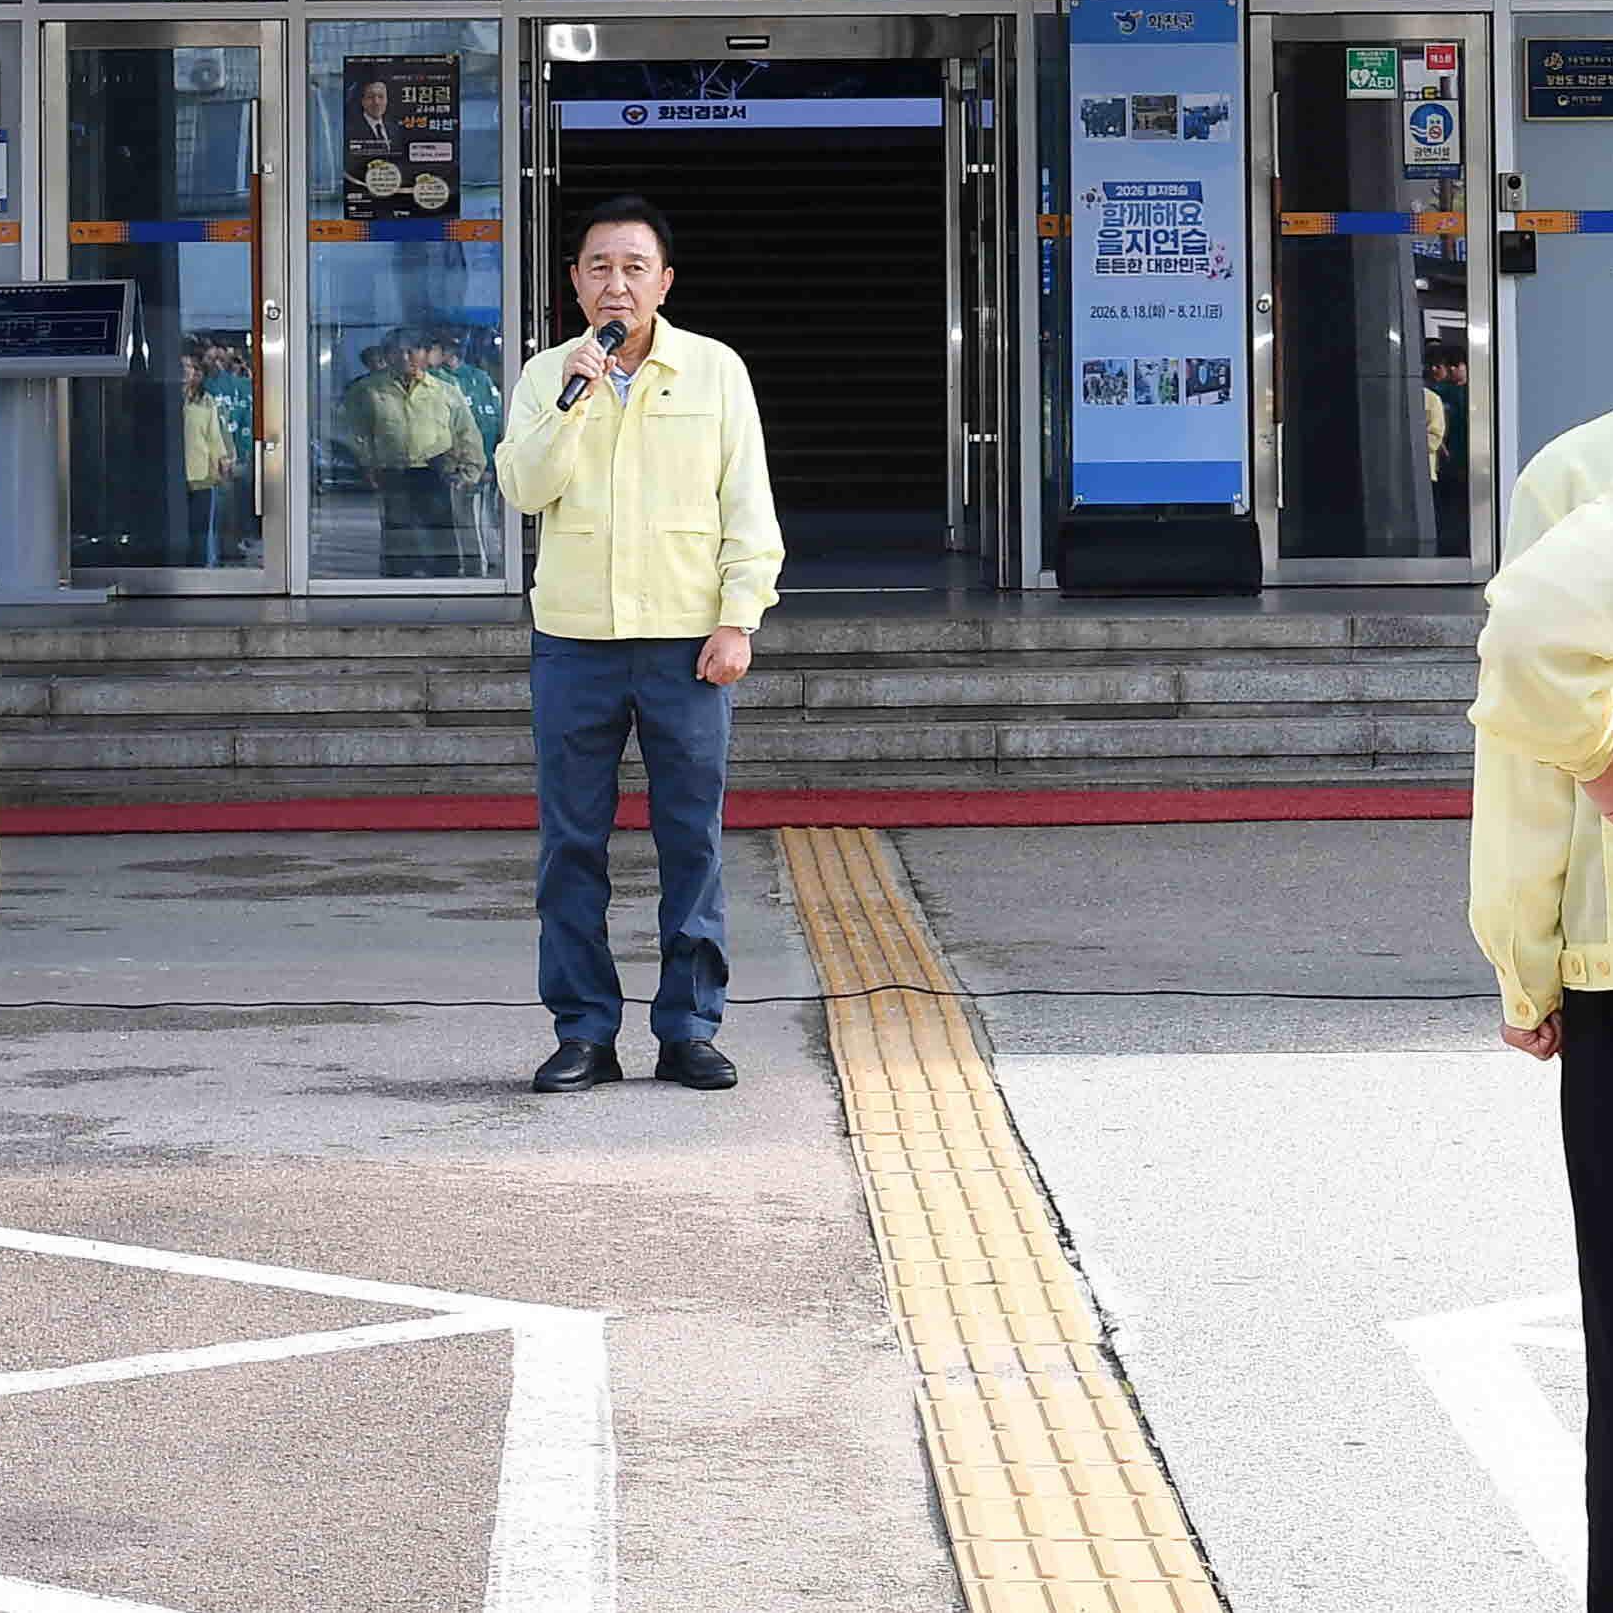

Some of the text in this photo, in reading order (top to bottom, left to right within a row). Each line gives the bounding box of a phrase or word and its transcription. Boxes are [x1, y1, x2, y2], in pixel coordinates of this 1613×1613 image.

[1368, 77, 1394, 89] AED
[657, 105, 747, 120] 화천경찰서
[1101, 202, 1203, 228] 함께해요
[1097, 228, 1208, 256] 을지연습
[1095, 257, 1210, 274] 든든한 대한민국
